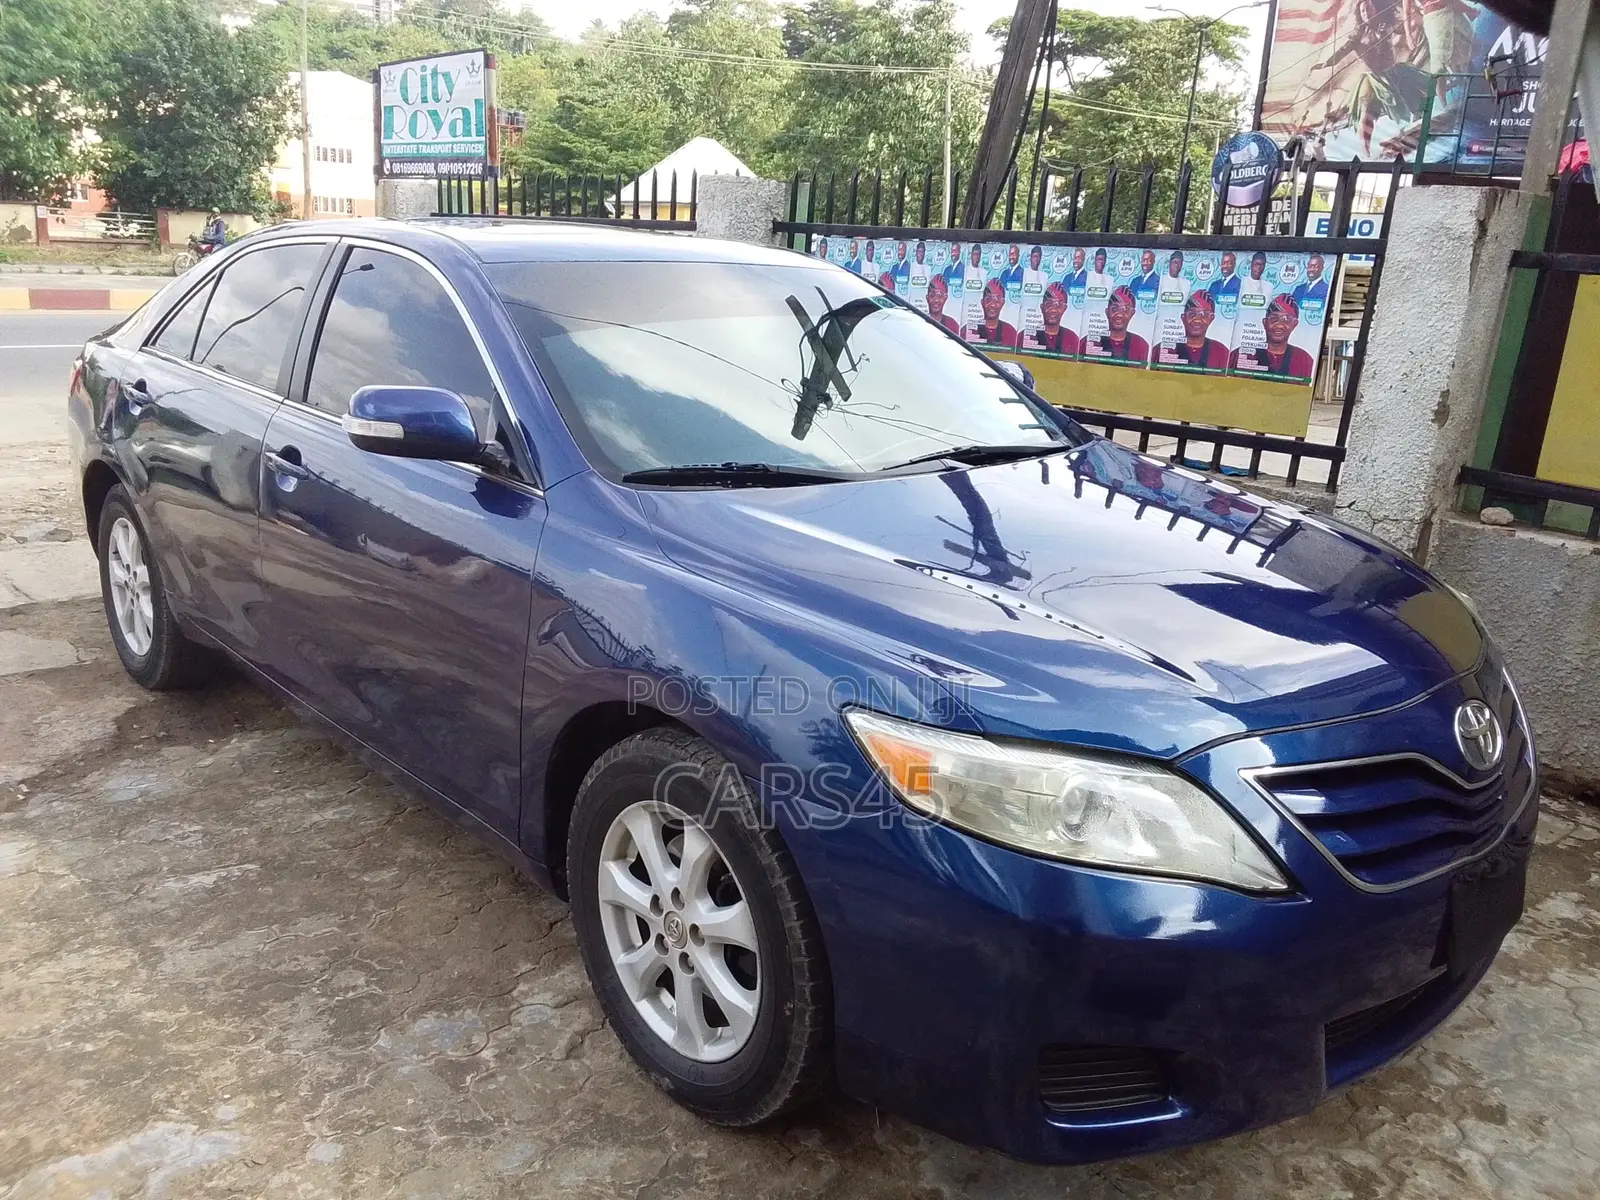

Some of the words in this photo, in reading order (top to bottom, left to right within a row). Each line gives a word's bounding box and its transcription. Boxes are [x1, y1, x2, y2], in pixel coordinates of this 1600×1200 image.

[400, 63, 460, 106] City
[1522, 80, 1541, 91] SH
[383, 98, 485, 140] Royal
[1489, 118, 1532, 127] HRITAGE
[384, 144, 418, 155] INTERSTATE
[418, 144, 452, 154] TRANSPORT
[452, 143, 483, 154] SERVICES
[1218, 164, 1269, 182] LDBERG
[1271, 199, 1291, 212] DE
